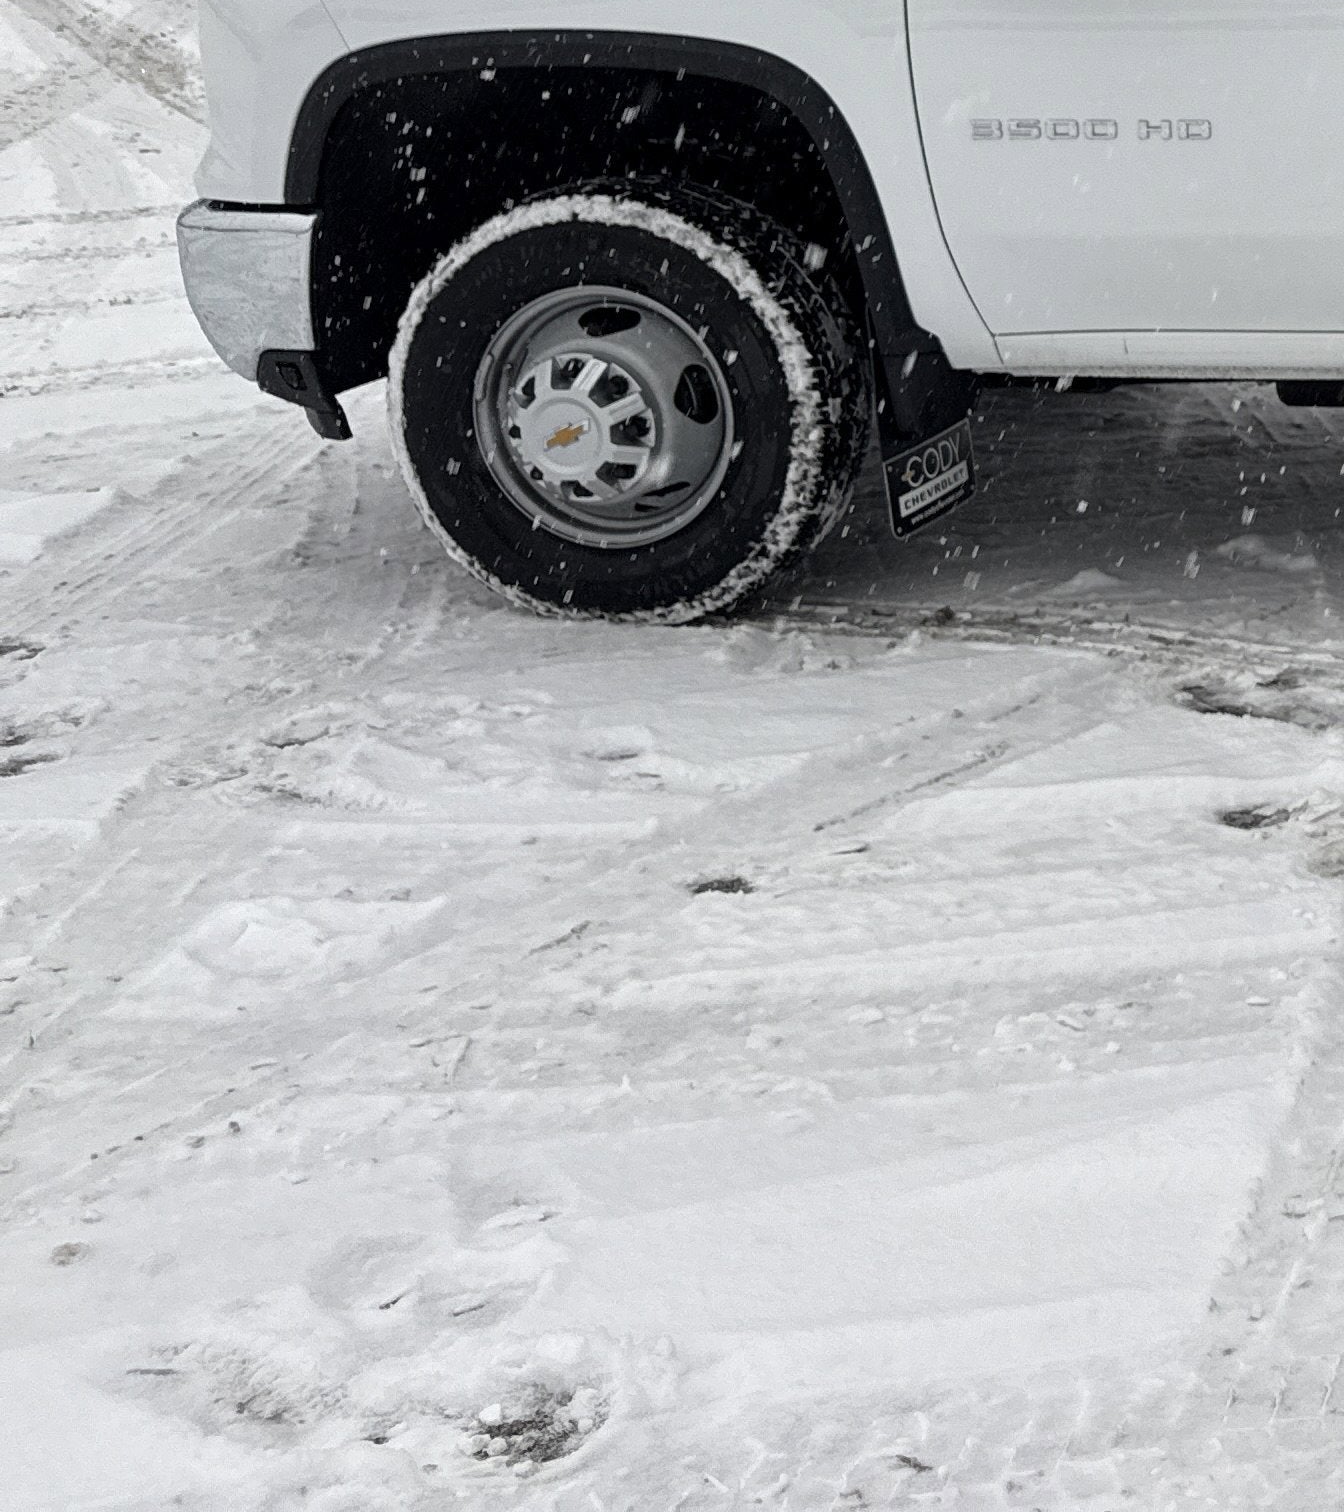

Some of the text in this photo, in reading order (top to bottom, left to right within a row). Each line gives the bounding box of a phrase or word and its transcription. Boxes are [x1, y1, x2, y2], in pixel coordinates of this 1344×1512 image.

[969, 118, 1212, 140] 3500 HD
[906, 431, 960, 487] CODY
[904, 468, 965, 510] CHEVROLET
